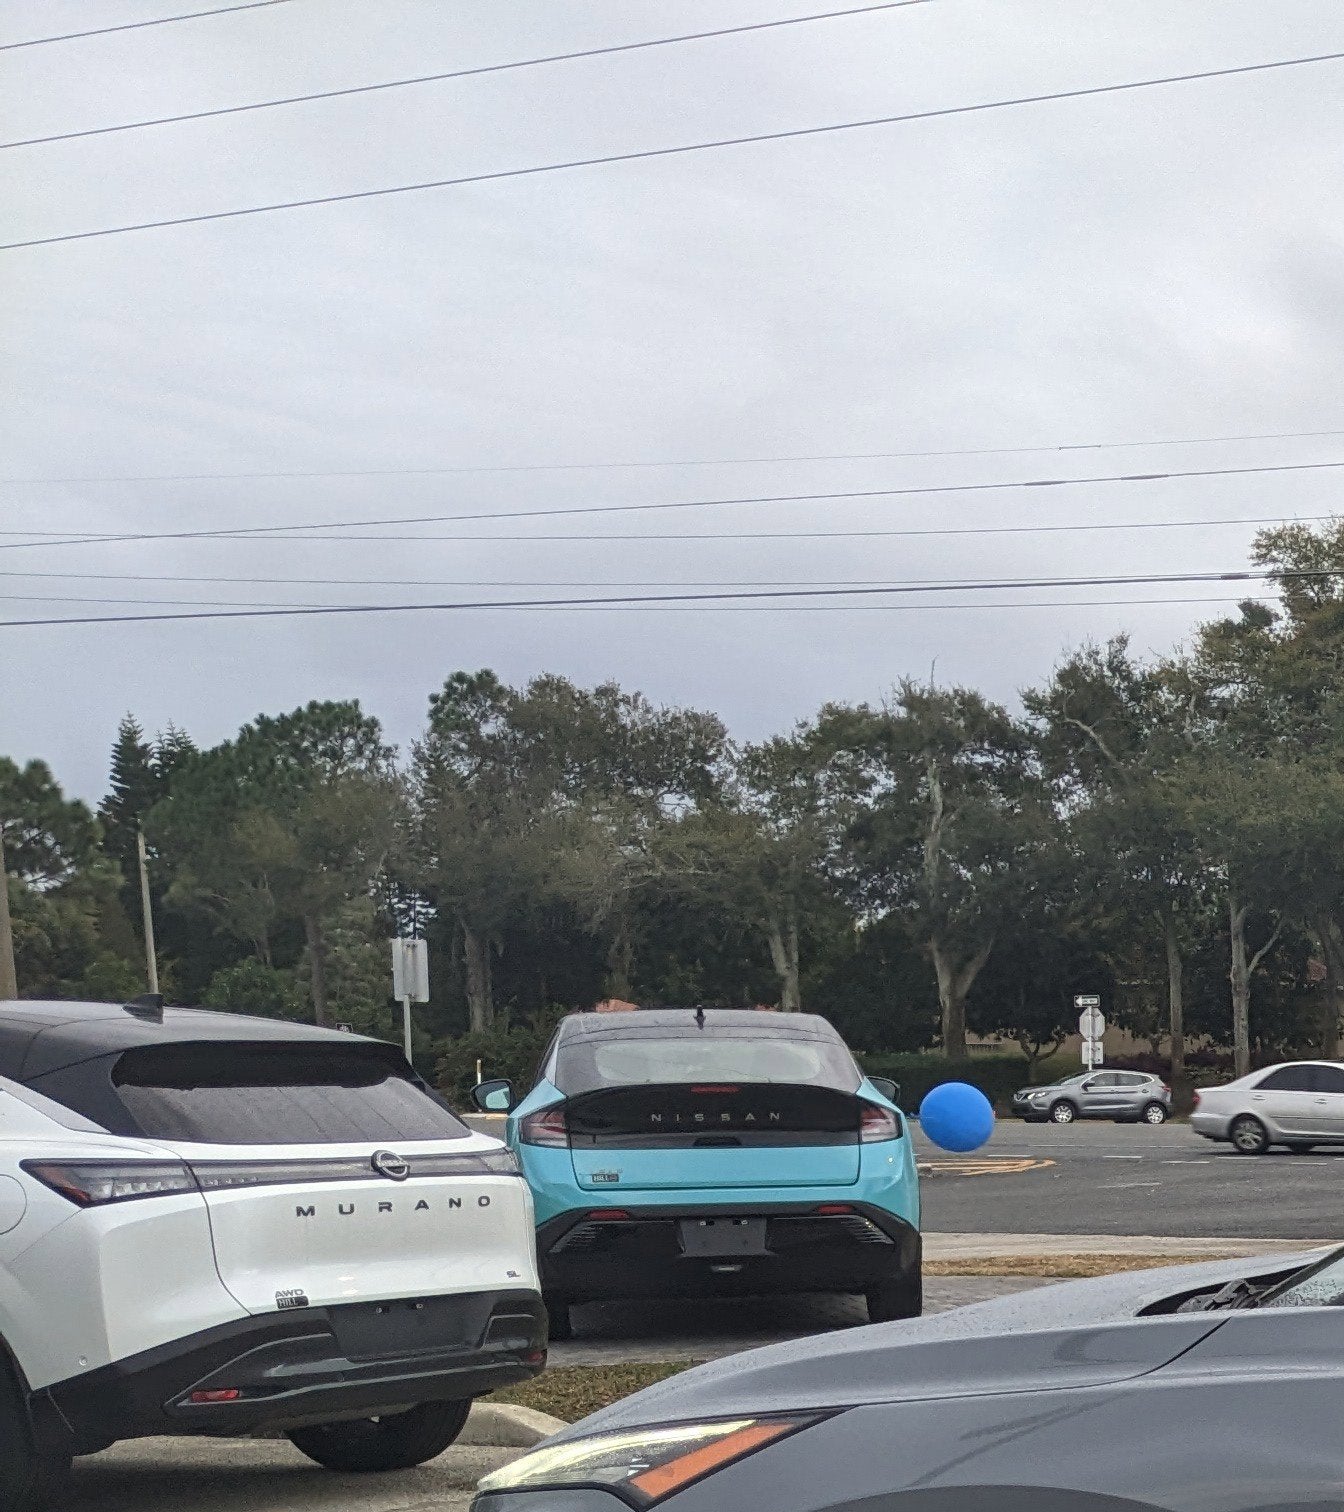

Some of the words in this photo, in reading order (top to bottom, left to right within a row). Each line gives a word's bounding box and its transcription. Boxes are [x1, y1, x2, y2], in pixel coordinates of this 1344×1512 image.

[651, 1111, 781, 1122] NISSAN
[296, 1195, 491, 1217] MURANO
[506, 1270, 521, 1278] SL
[275, 1289, 304, 1298] AWD
